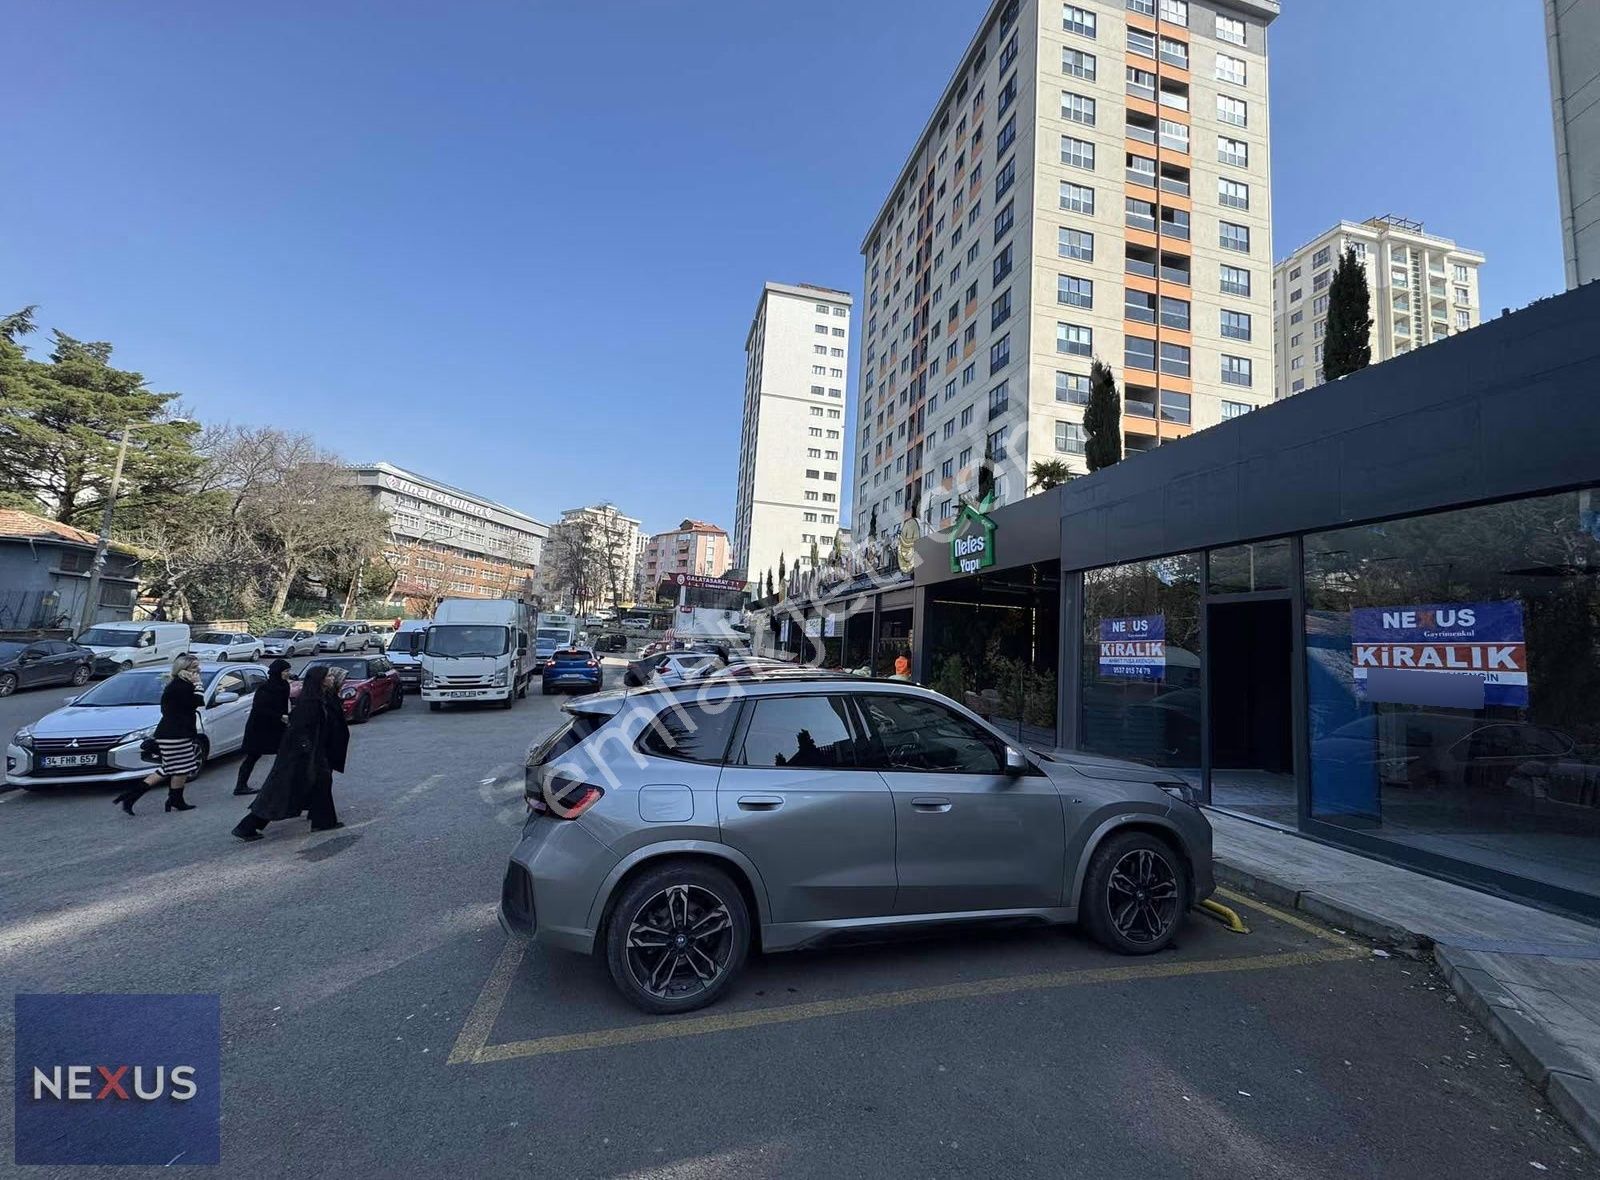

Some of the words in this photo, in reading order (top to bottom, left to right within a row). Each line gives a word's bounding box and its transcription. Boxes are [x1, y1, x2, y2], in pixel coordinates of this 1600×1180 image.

[399, 479, 433, 499] final
[435, 492, 483, 515] okulları
[686, 576, 728, 585] GALATASARAY
[1382, 608, 1476, 629] NEXUS
[1424, 630, 1475, 638] Gayrimenkul
[46, 757, 57, 765] 34
[60, 756, 77, 765] FHR
[80, 755, 96, 764] 657
